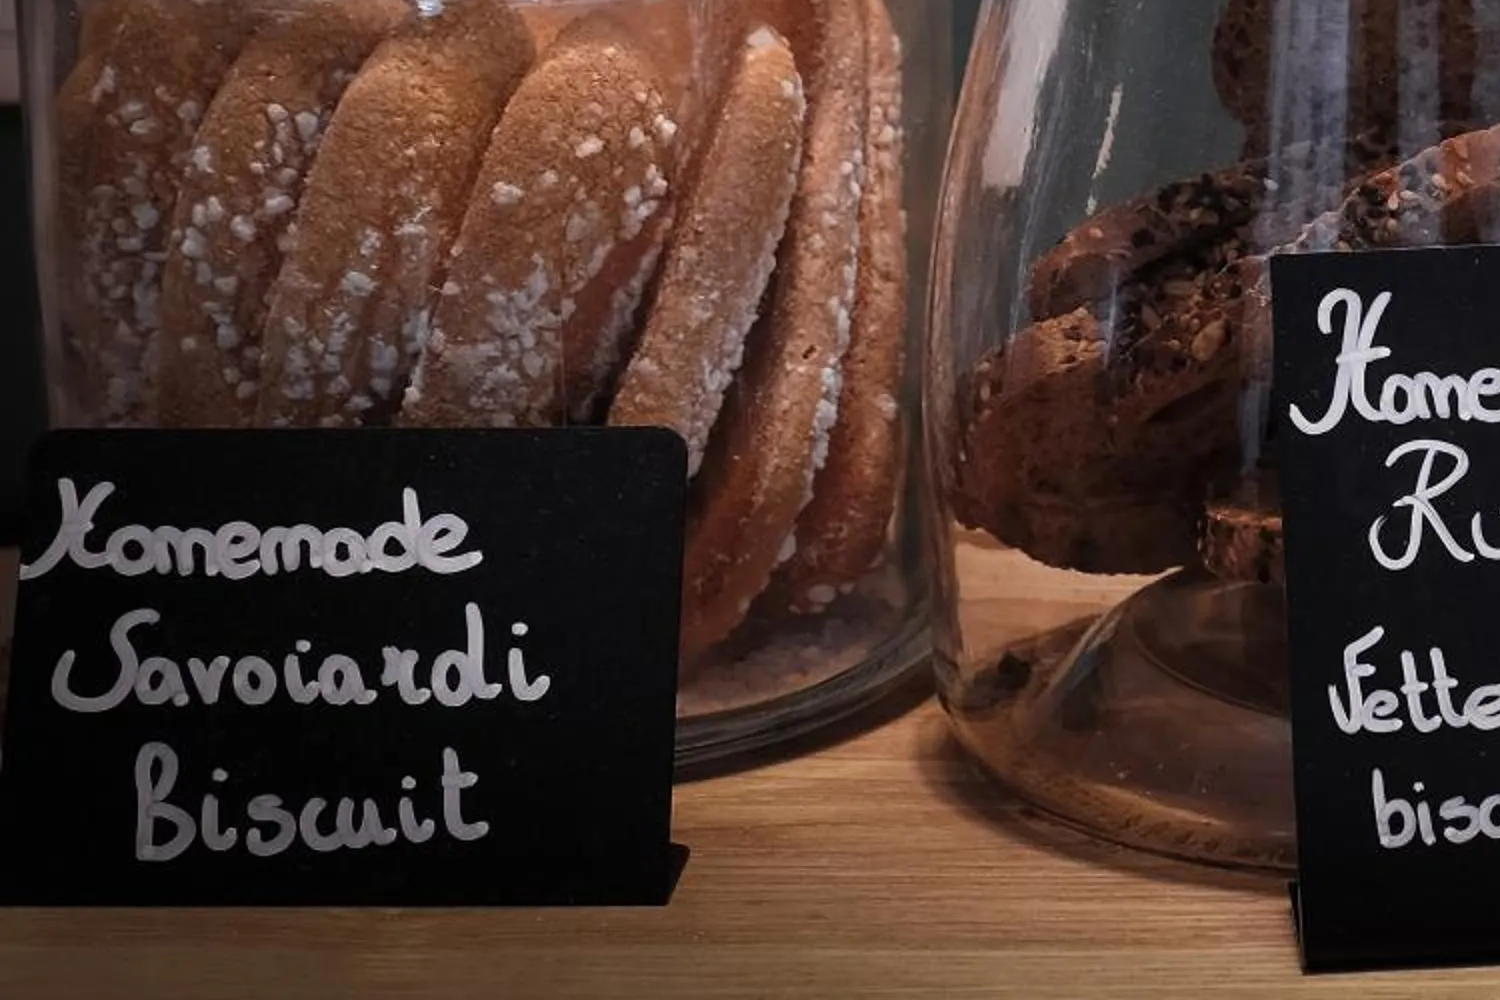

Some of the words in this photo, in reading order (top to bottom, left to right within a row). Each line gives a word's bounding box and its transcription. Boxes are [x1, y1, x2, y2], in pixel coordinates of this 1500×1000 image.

[19, 477, 484, 581] Homemade
[51, 601, 551, 712] Savoiardi
[135, 741, 489, 862] Biscuit
